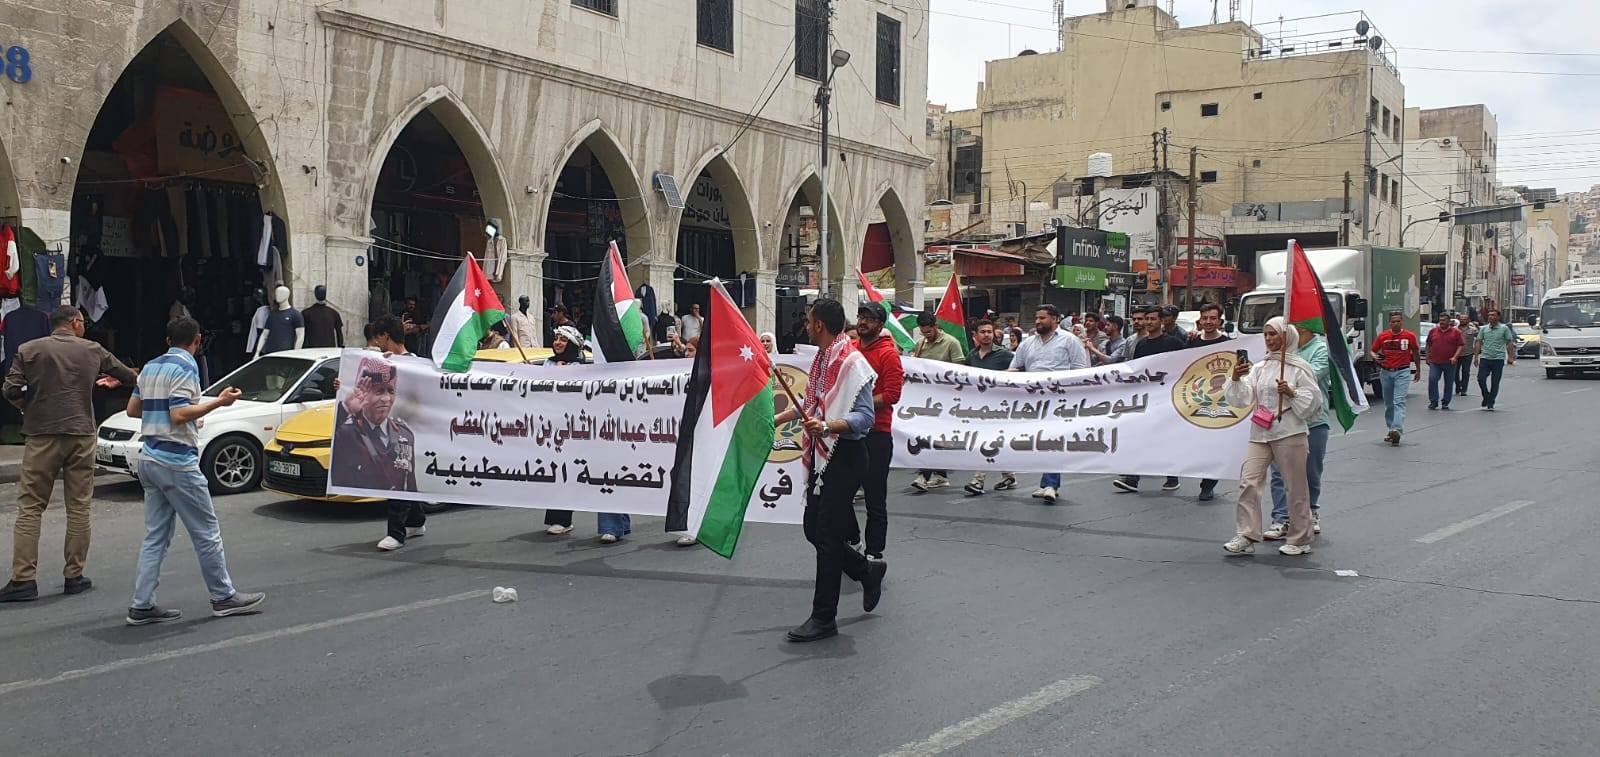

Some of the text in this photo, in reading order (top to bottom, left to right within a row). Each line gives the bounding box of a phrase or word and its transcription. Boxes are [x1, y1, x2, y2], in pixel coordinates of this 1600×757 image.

[0, 43, 32, 83] 8
[1072, 239, 1102, 258] Infinix
[1046, 373, 1110, 395] الحسين
[1110, 368, 1168, 386] جامعة
[449, 409, 489, 442] المعظم
[896, 393, 1149, 424] للوصاية الهاشمية على
[490, 411, 534, 446] الحسين
[536, 414, 553, 449] بن
[554, 408, 597, 453] الثاني
[905, 425, 1118, 463] المقدسات في القدس
[424, 452, 568, 488] الفلسطينية
[759, 467, 793, 509] في
